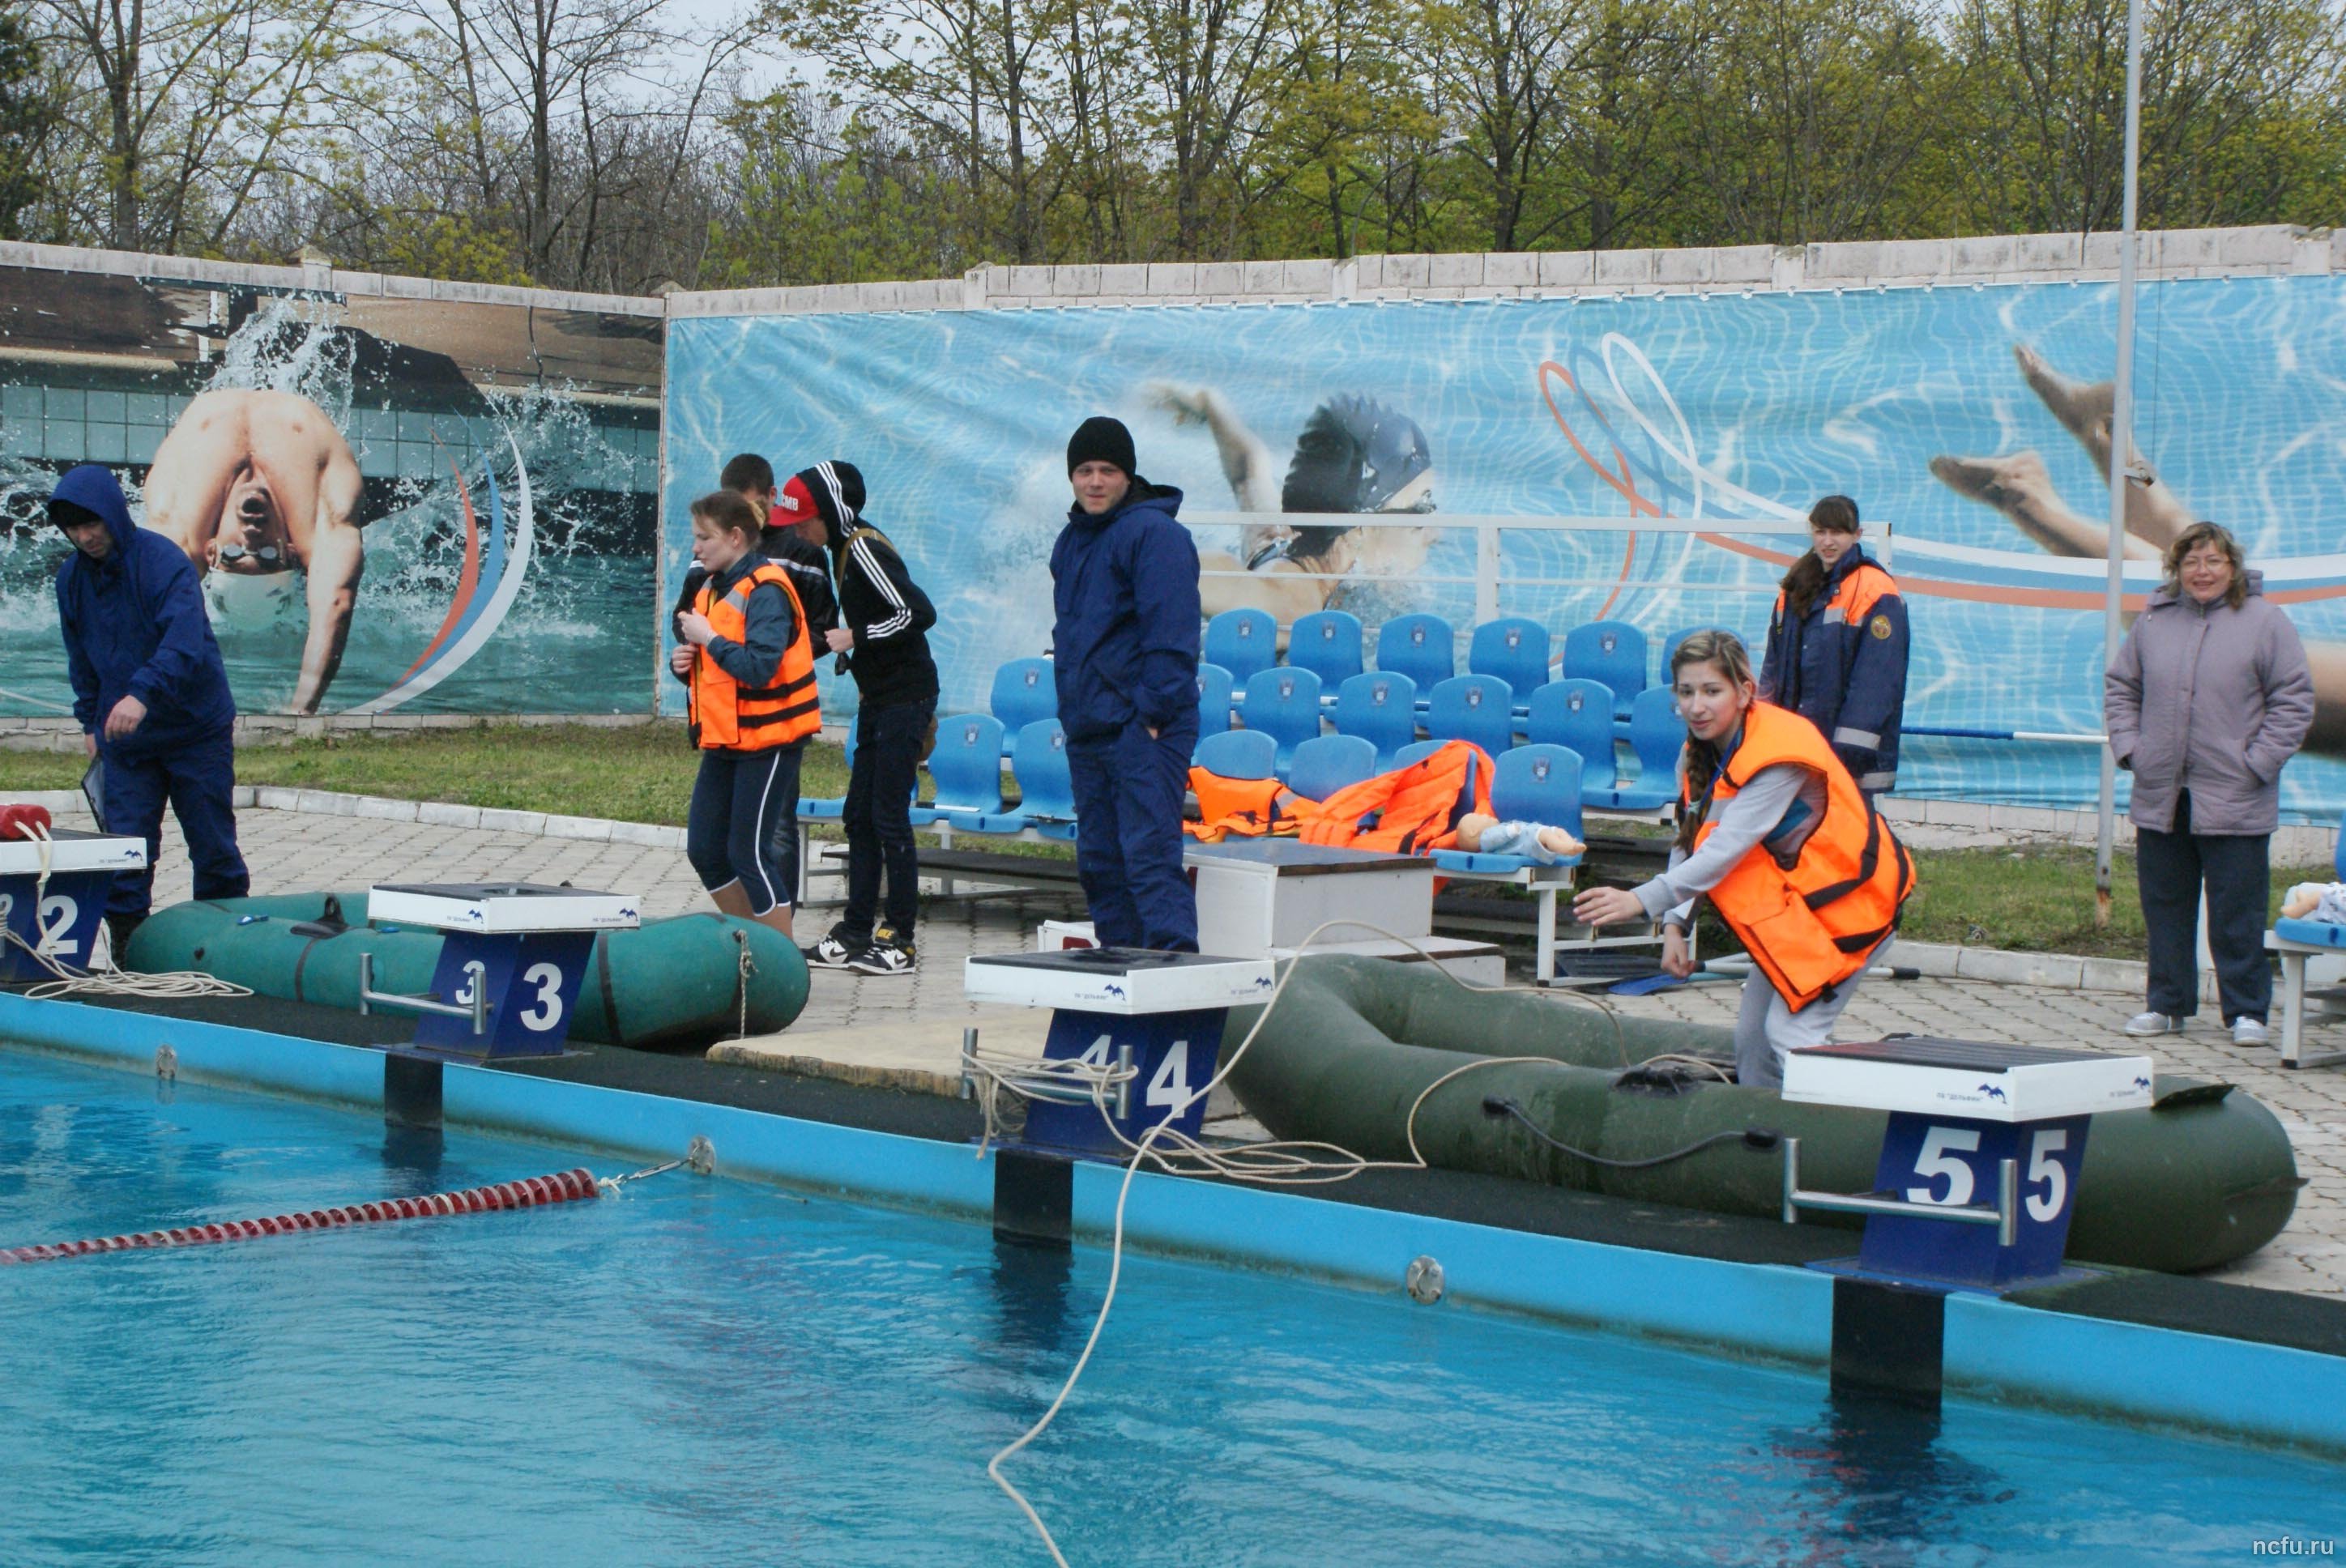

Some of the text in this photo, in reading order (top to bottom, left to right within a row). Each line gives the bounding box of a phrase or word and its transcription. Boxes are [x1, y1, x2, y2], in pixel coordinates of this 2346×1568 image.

[36, 895, 78, 956] 2
[455, 960, 485, 1004] 3
[520, 962, 563, 1031] 3
[1146, 1040, 1192, 1118] 4
[1907, 1126, 1981, 1205] 5
[2025, 1129, 2067, 1222] 5
